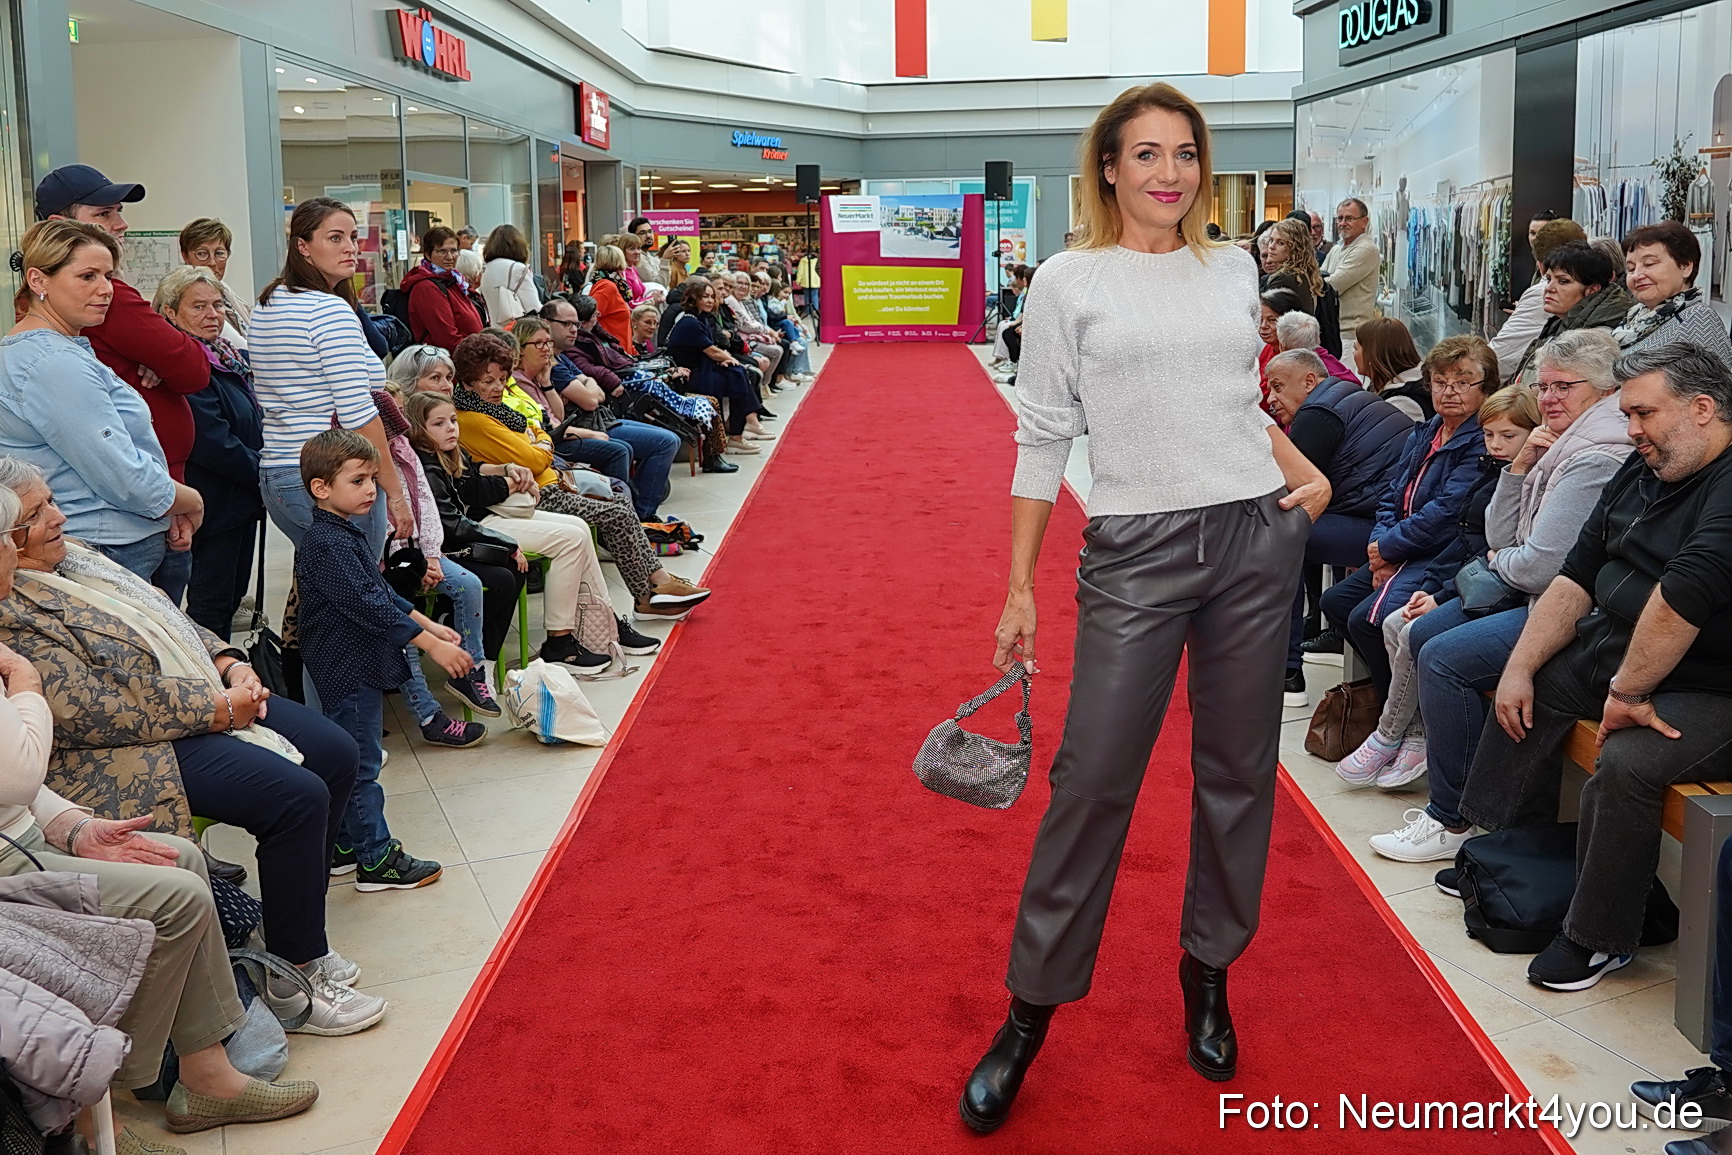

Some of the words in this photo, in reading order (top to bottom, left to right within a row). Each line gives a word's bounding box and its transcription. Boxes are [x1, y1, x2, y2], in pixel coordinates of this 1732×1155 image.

[1339, 0, 1419, 49] DOUGLAS
[397, 8, 471, 81] WÖHRL
[732, 130, 781, 147] Spielwaren
[762, 148, 788, 160] Krömer
[649, 218, 684, 226] erschenken
